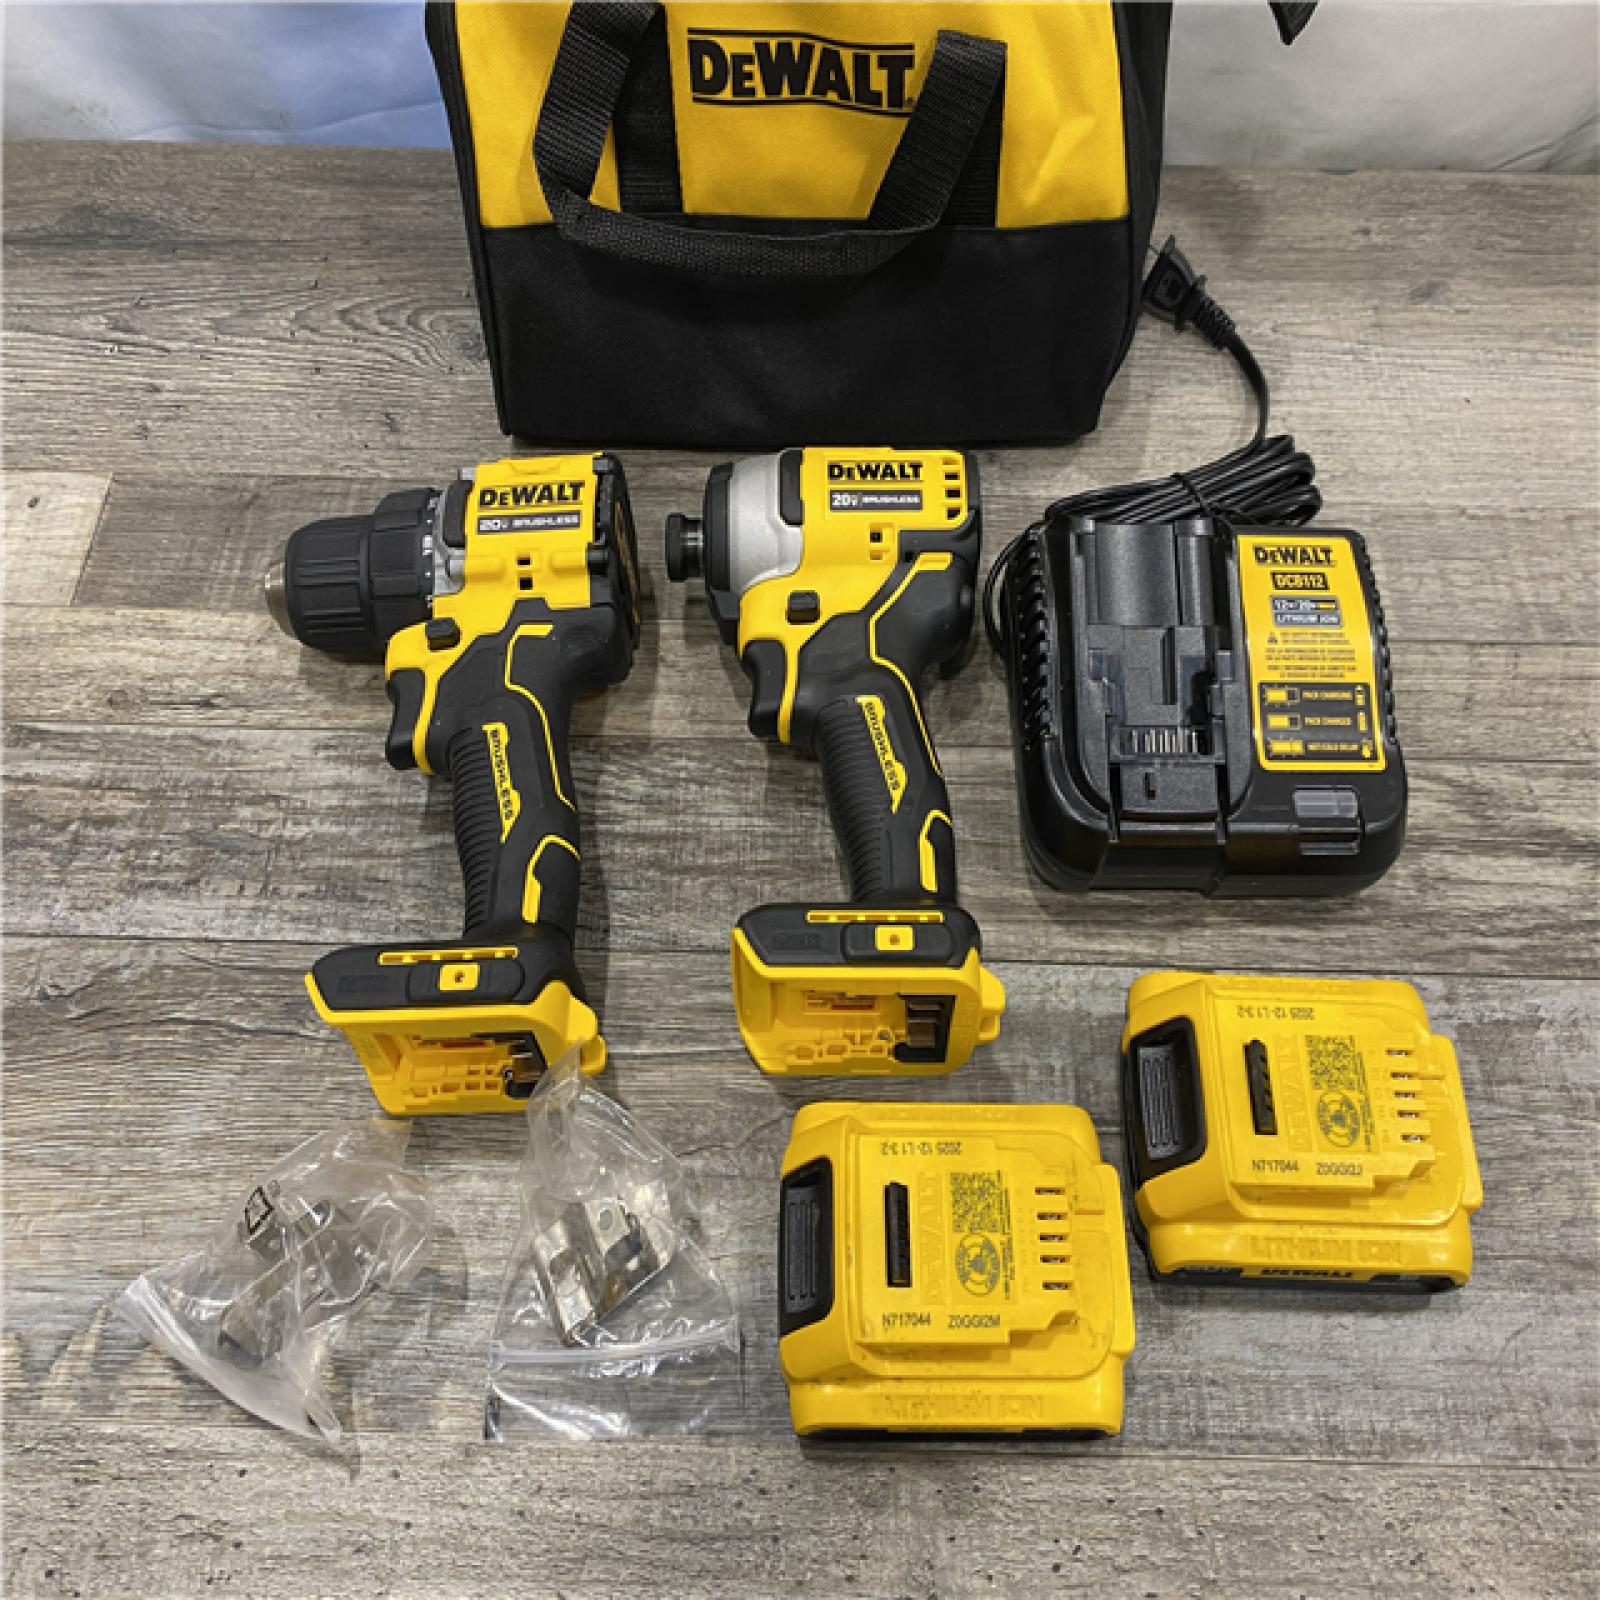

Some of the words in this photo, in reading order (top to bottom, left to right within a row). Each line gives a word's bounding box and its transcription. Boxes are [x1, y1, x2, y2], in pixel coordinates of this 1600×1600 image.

[688, 39, 914, 108] DEWALT
[828, 463, 923, 481] DEWALT
[479, 482, 585, 506] DEWALT
[1254, 546, 1333, 564] DEWALT
